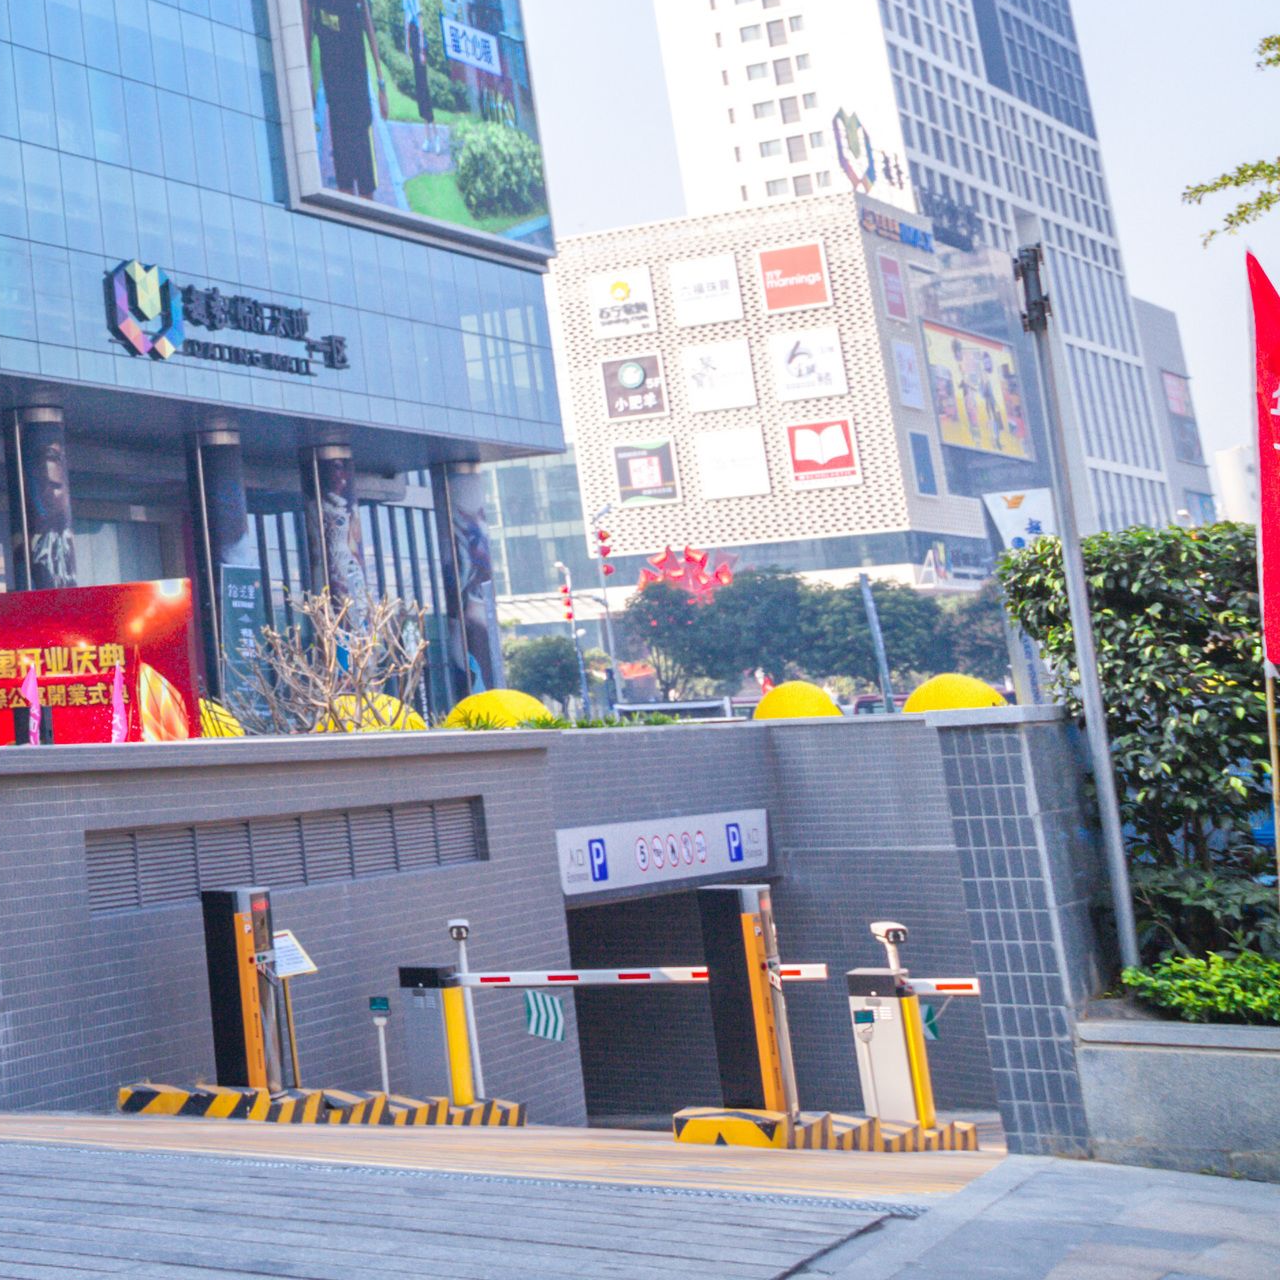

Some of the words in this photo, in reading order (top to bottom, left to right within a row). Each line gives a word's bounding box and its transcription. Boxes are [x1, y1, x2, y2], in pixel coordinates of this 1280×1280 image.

[766, 272, 821, 288] mannings
[639, 845, 647, 864] 5
[729, 826, 739, 859] P
[592, 841, 604, 879] P
